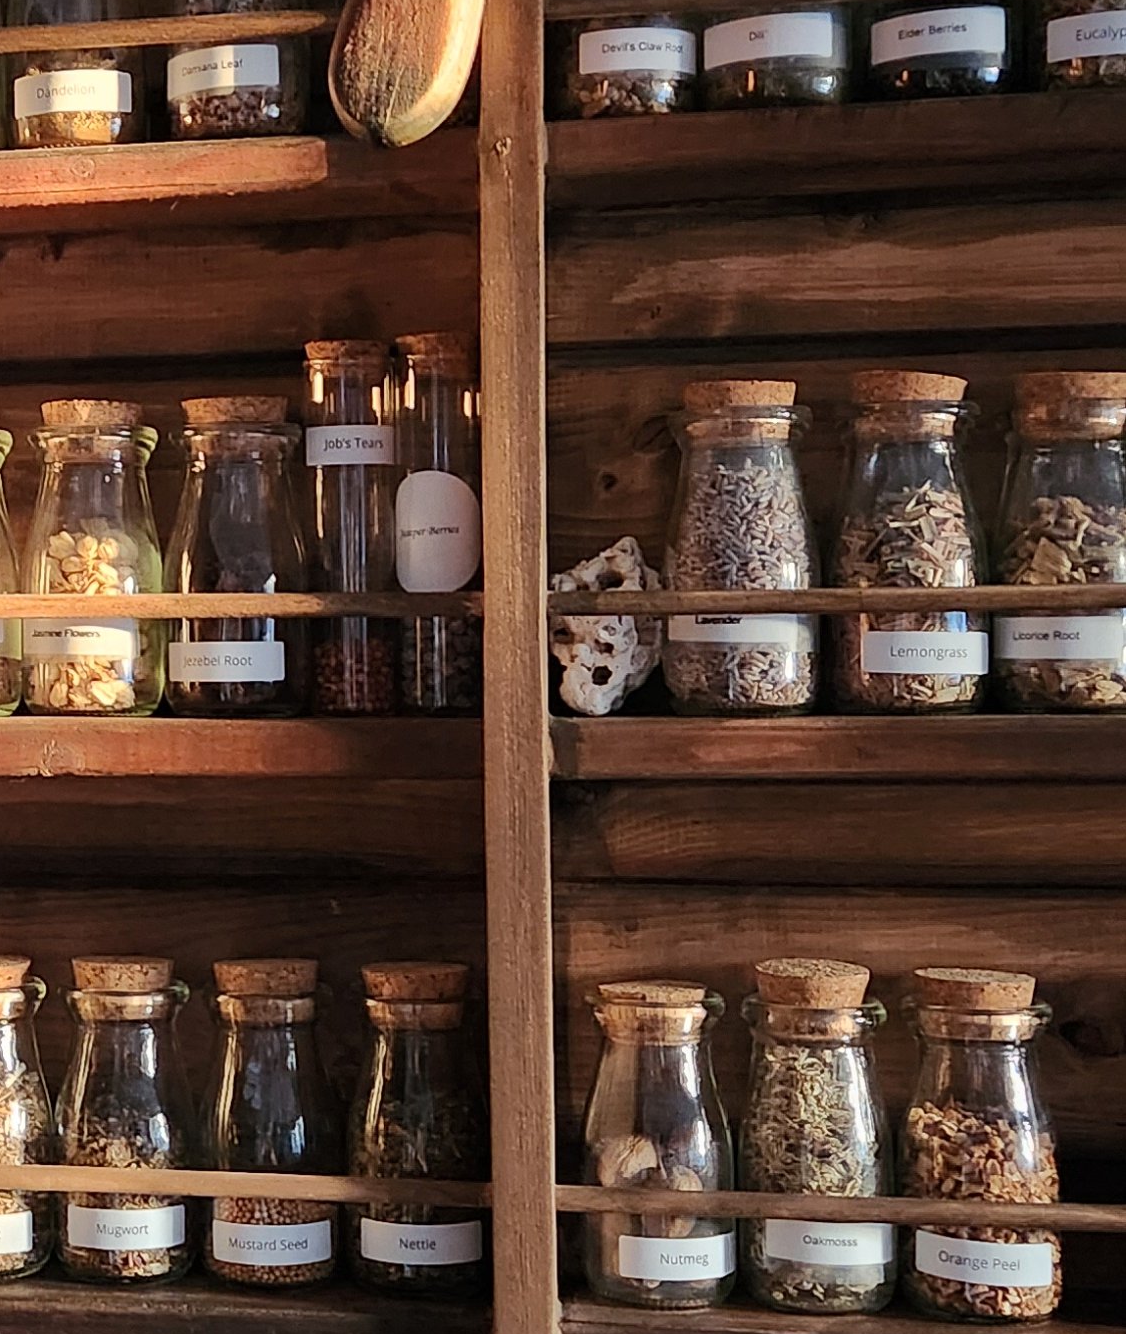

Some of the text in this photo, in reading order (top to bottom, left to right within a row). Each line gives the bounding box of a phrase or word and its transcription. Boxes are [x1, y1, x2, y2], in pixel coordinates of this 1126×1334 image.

[898, 24, 968, 41] Elder Berries
[601, 41, 684, 54] Devil's Claw Root
[181, 59, 244, 76] Damiana Leaf
[36, 84, 95, 99] Dandelion
[323, 437, 384, 452] Job's Tears
[695, 615, 743, 625] Lavender
[32, 628, 101, 638] Jasmine Flowers
[1012, 630, 1081, 641] Licorice Root
[182, 654, 253, 667] Jezebel Root
[890, 646, 968, 661] Lemongrass
[96, 1223, 149, 1237] Mugwort
[228, 1237, 309, 1251] Mustard Seed
[399, 1238, 437, 1250] Nettle
[660, 1253, 709, 1267] Nutmeg
[938, 1250, 1021, 1271] Orange Peel
